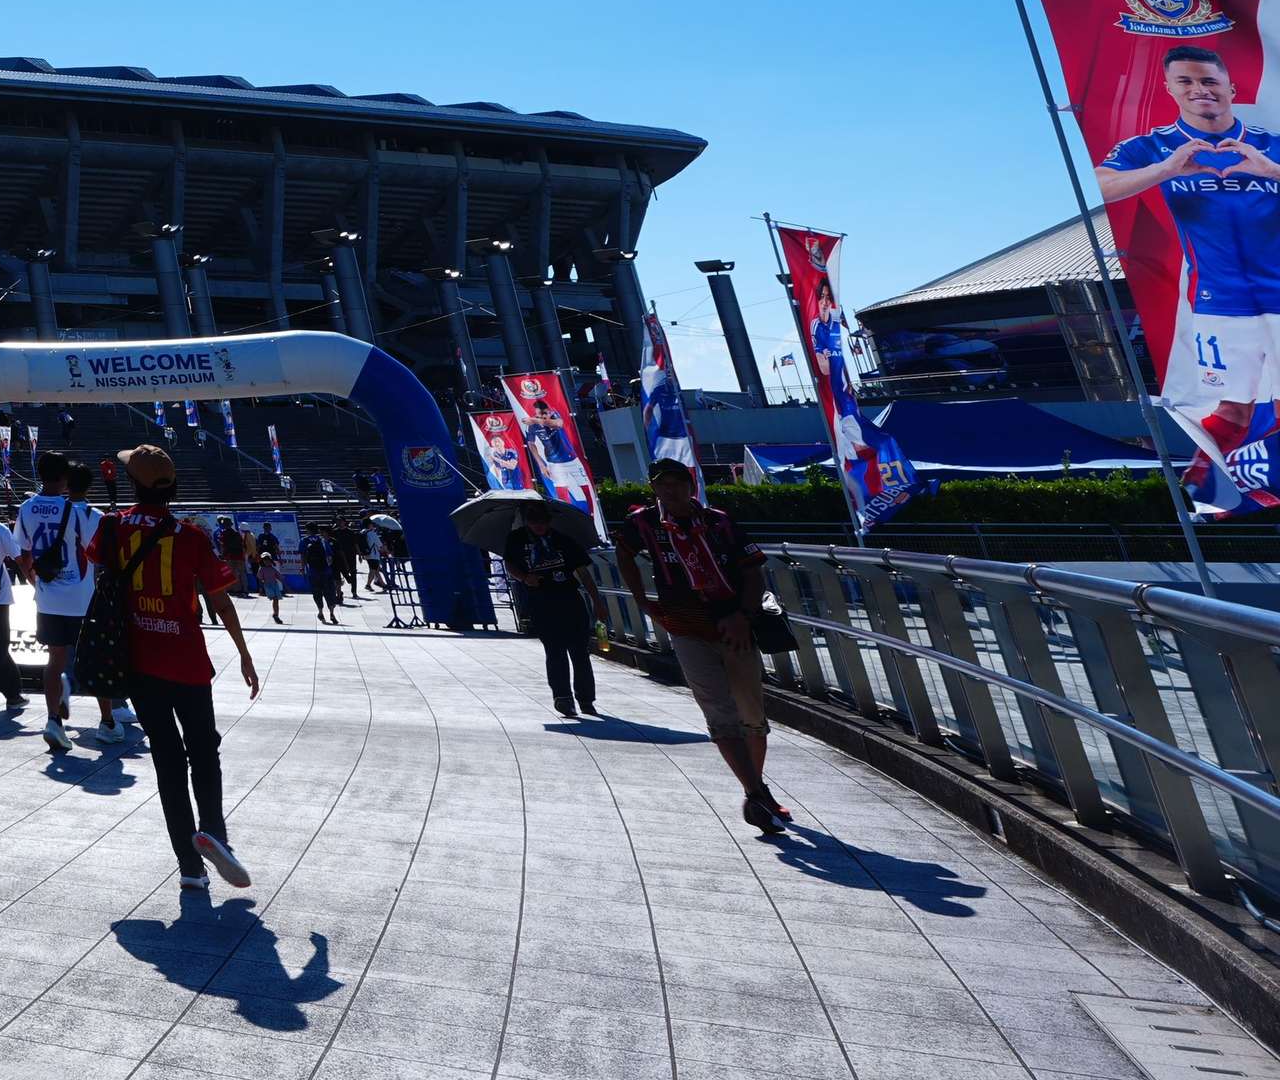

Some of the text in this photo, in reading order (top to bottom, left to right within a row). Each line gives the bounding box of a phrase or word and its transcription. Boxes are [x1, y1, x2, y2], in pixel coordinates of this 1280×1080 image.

[1129, 22, 1176, 34] Yokohama
[1171, 179, 1279, 194] NISSAN
[1195, 332, 1227, 370] 11
[88, 353, 213, 375] WELCOME
[95, 372, 215, 388] NISSAN STADIUM
[878, 460, 909, 487] 27
[138, 595, 165, 614] ONO
